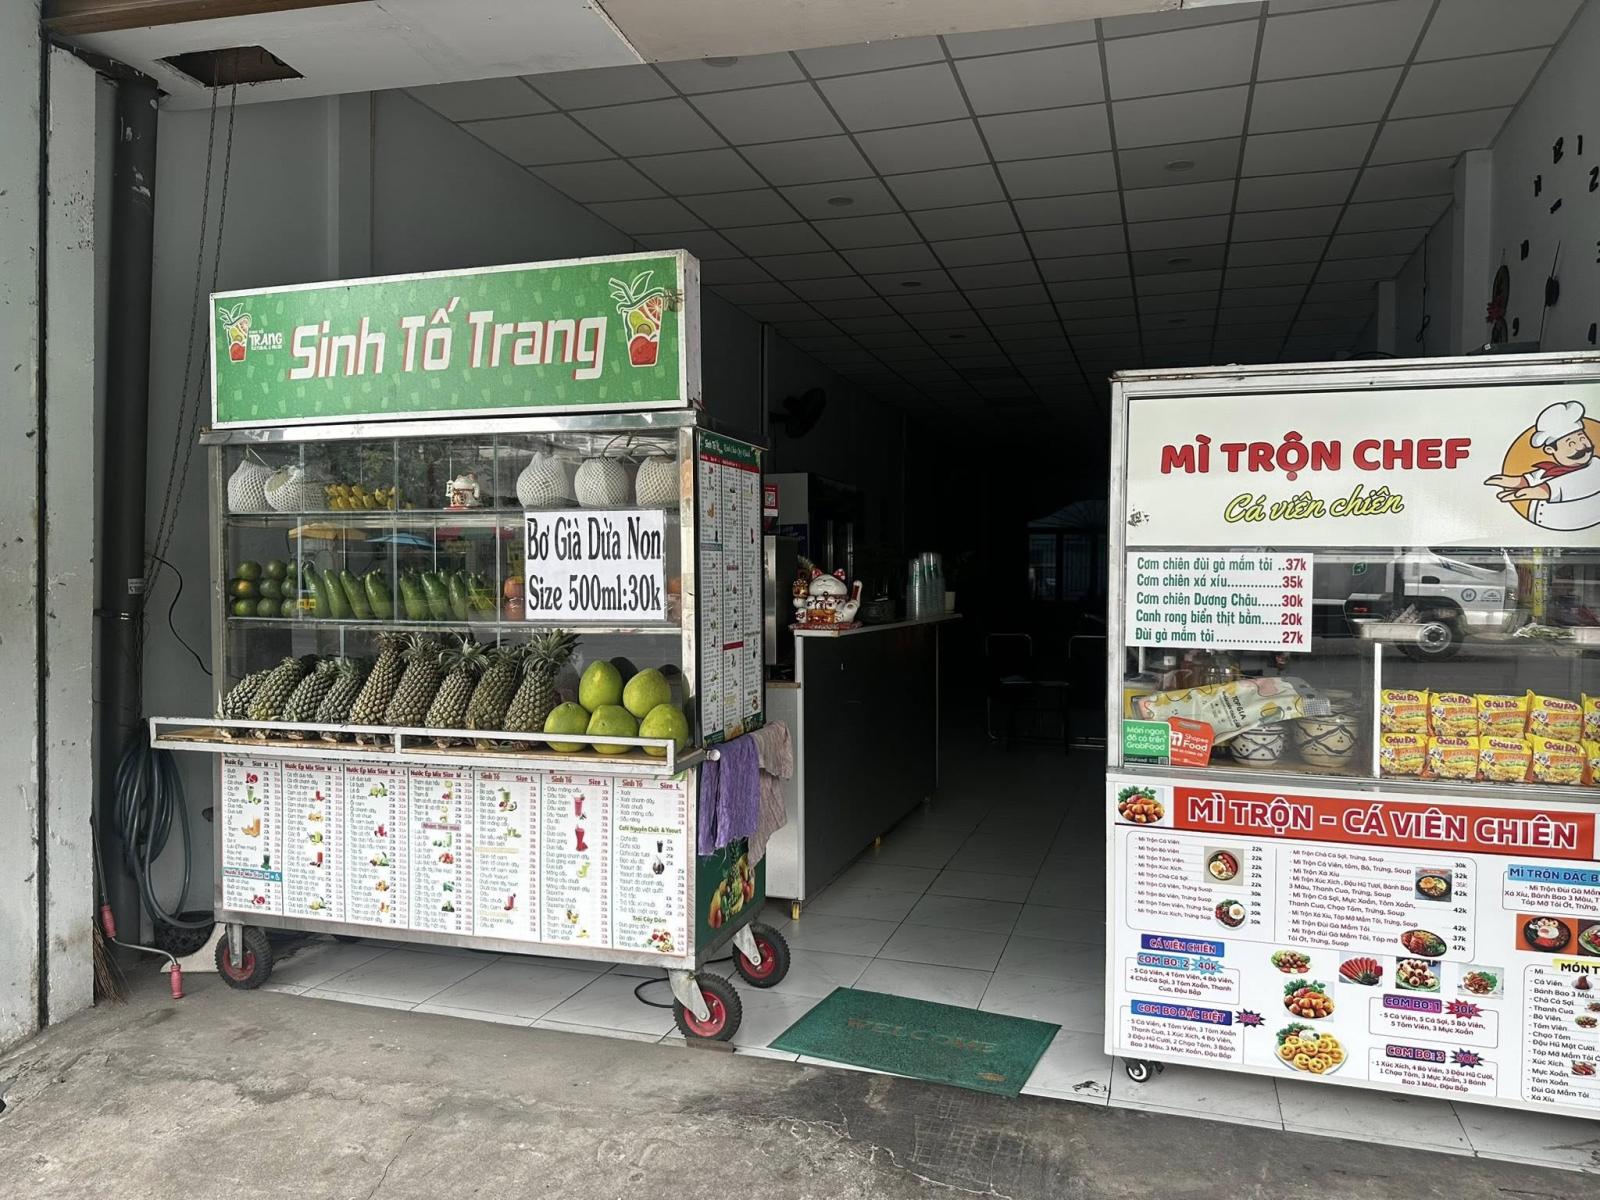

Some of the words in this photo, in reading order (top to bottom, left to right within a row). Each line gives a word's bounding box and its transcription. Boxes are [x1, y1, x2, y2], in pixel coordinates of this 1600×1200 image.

[288, 316, 386, 380] Sinh
[400, 296, 461, 372] Tố
[467, 310, 608, 380] Trang
[1160, 434, 1212, 474] MÌ
[1220, 430, 1342, 481] TRỘN
[1352, 437, 1472, 471] CHEF
[1223, 492, 1266, 524] Cá
[1269, 490, 1326, 521] viên
[1329, 483, 1405, 519] chiên
[527, 517, 550, 561] Bơ
[554, 516, 582, 561] Già
[587, 517, 622, 561] Dừa
[627, 516, 662, 561] Non
[1137, 556, 1159, 570] Cơm
[1162, 556, 1190, 570] chiên
[1193, 557, 1210, 570] đùi
[1213, 557, 1226, 574] gà
[1228, 554, 1255, 571] mắm
[1258, 556, 1273, 571] tỏi
[1136, 574, 1159, 587] Cơm
[1162, 574, 1190, 587] chiên
[1193, 574, 1206, 587] xá
[1282, 576, 1303, 588] 35k
[528, 574, 563, 611] Size
[568, 574, 662, 611] 500ml:30k
[1136, 592, 1159, 605] Cơm
[1162, 592, 1190, 606] chiên
[1194, 592, 1227, 608] Dương
[1282, 594, 1303, 608] 30k
[1136, 609, 1161, 622] Canh
[1164, 614, 1187, 625] rong
[1190, 608, 1213, 624] biển
[1216, 611, 1235, 627] thịt
[1281, 613, 1303, 626] 20k
[1135, 628, 1152, 641] Đùi
[1155, 628, 1168, 644] gà
[1171, 626, 1197, 642] mắm
[1200, 628, 1214, 642] tỏi
[1282, 631, 1303, 644] 27k
[1126, 742, 1166, 751] GrabFood
[1184, 740, 1208, 752] Food
[660, 782, 674, 790] Size
[1188, 792, 1225, 824] MÌ
[1229, 797, 1313, 835] TRỘN
[1342, 804, 1388, 836] CÁ
[1389, 807, 1468, 842] VIÊN
[1474, 814, 1577, 850] CHIÊN
[1510, 867, 1524, 877] MÌ
[1526, 868, 1560, 881] TRỘN
[1563, 871, 1587, 884] ĐẶC
[1187, 940, 1216, 954] CHIÊN
[1138, 954, 1160, 965] COM
[1182, 960, 1189, 968] 2
[1198, 962, 1216, 971] 40k
[1560, 962, 1590, 974] MÓN
[1137, 1002, 1160, 1014] COM
[1162, 1005, 1178, 1016] BO
[1384, 996, 1411, 1008] COM
[1454, 1004, 1474, 1015] 30k
[1386, 1046, 1414, 1058] COM
